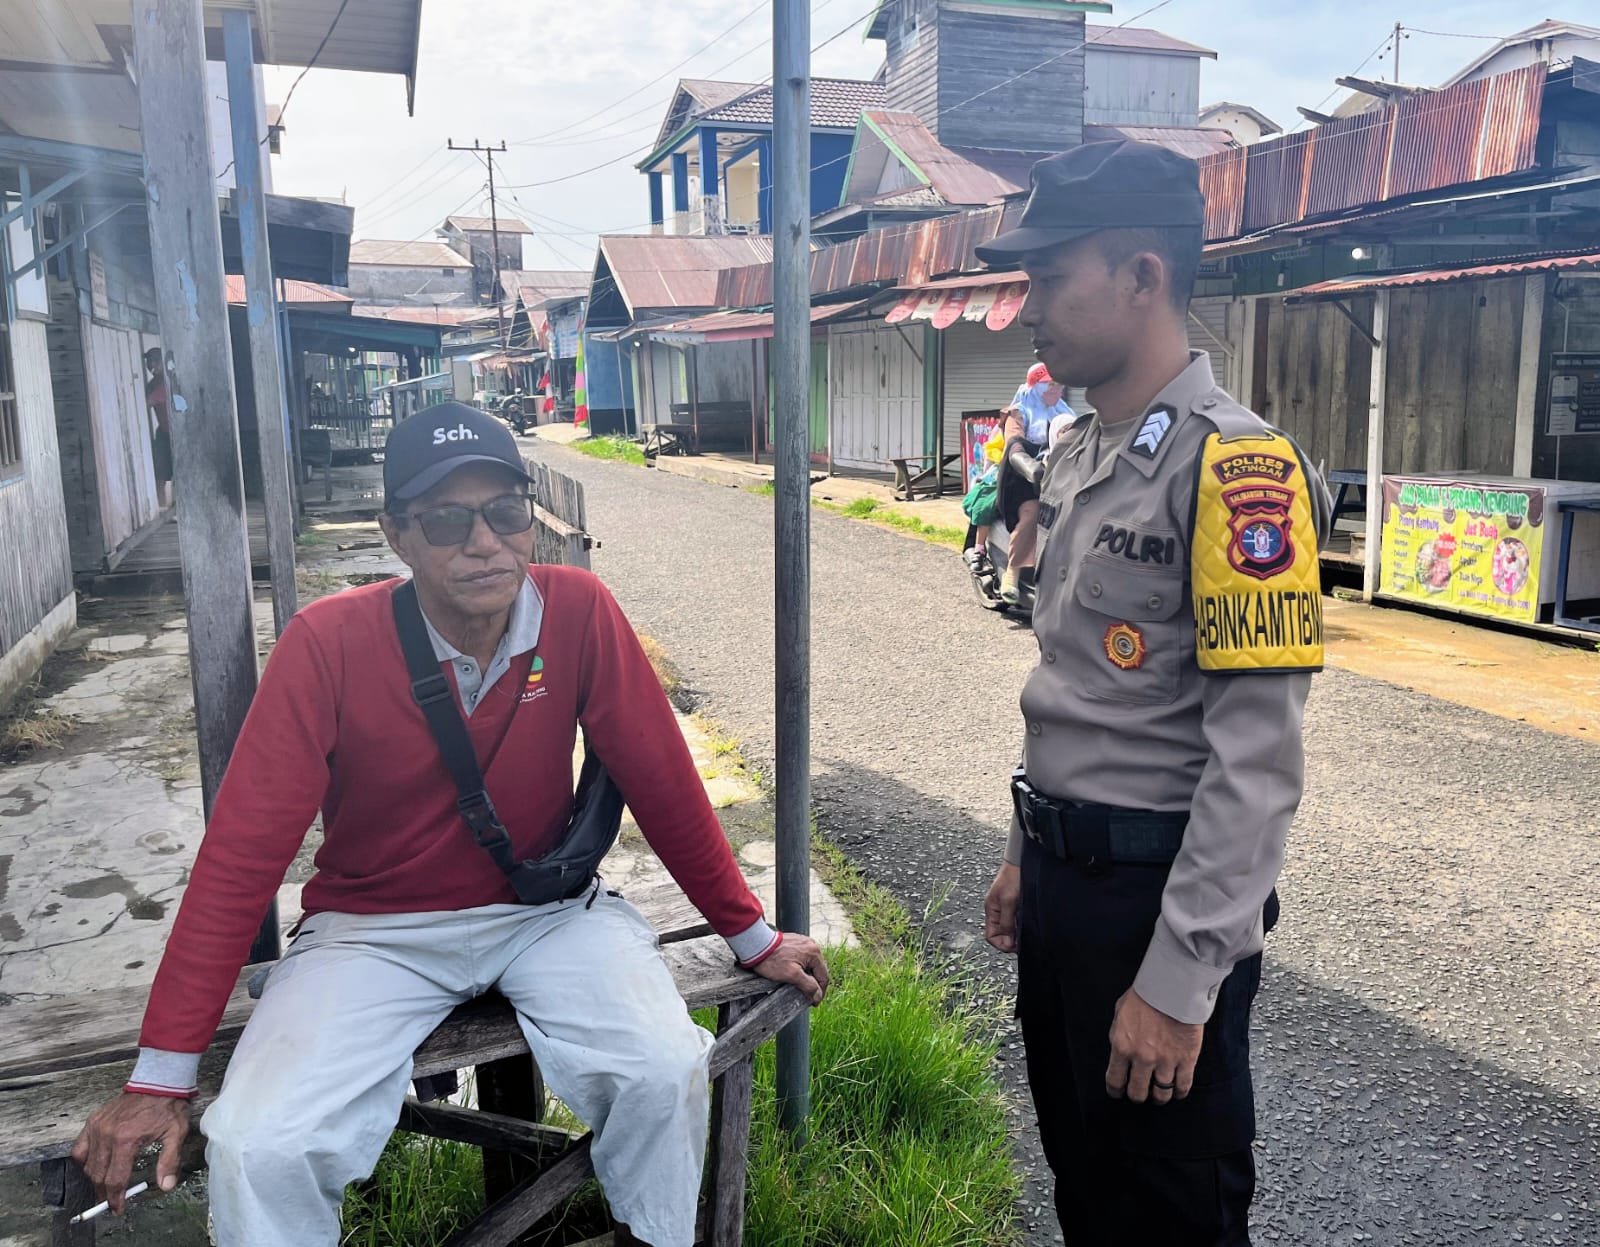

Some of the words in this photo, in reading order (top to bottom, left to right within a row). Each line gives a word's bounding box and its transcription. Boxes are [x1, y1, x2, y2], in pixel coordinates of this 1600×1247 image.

[432, 423, 479, 445] Sch.
[1222, 456, 1284, 471] POLRES
[1223, 465, 1283, 479] KATINGAN
[1398, 484, 1416, 506] JUS
[1415, 484, 1441, 508] BUAH
[1448, 486, 1482, 512] PISANG
[1482, 489, 1529, 517] KEMBUNG
[1464, 520, 1478, 537] Jus
[1479, 520, 1498, 541] Buah
[1094, 523, 1175, 565] POLRI
